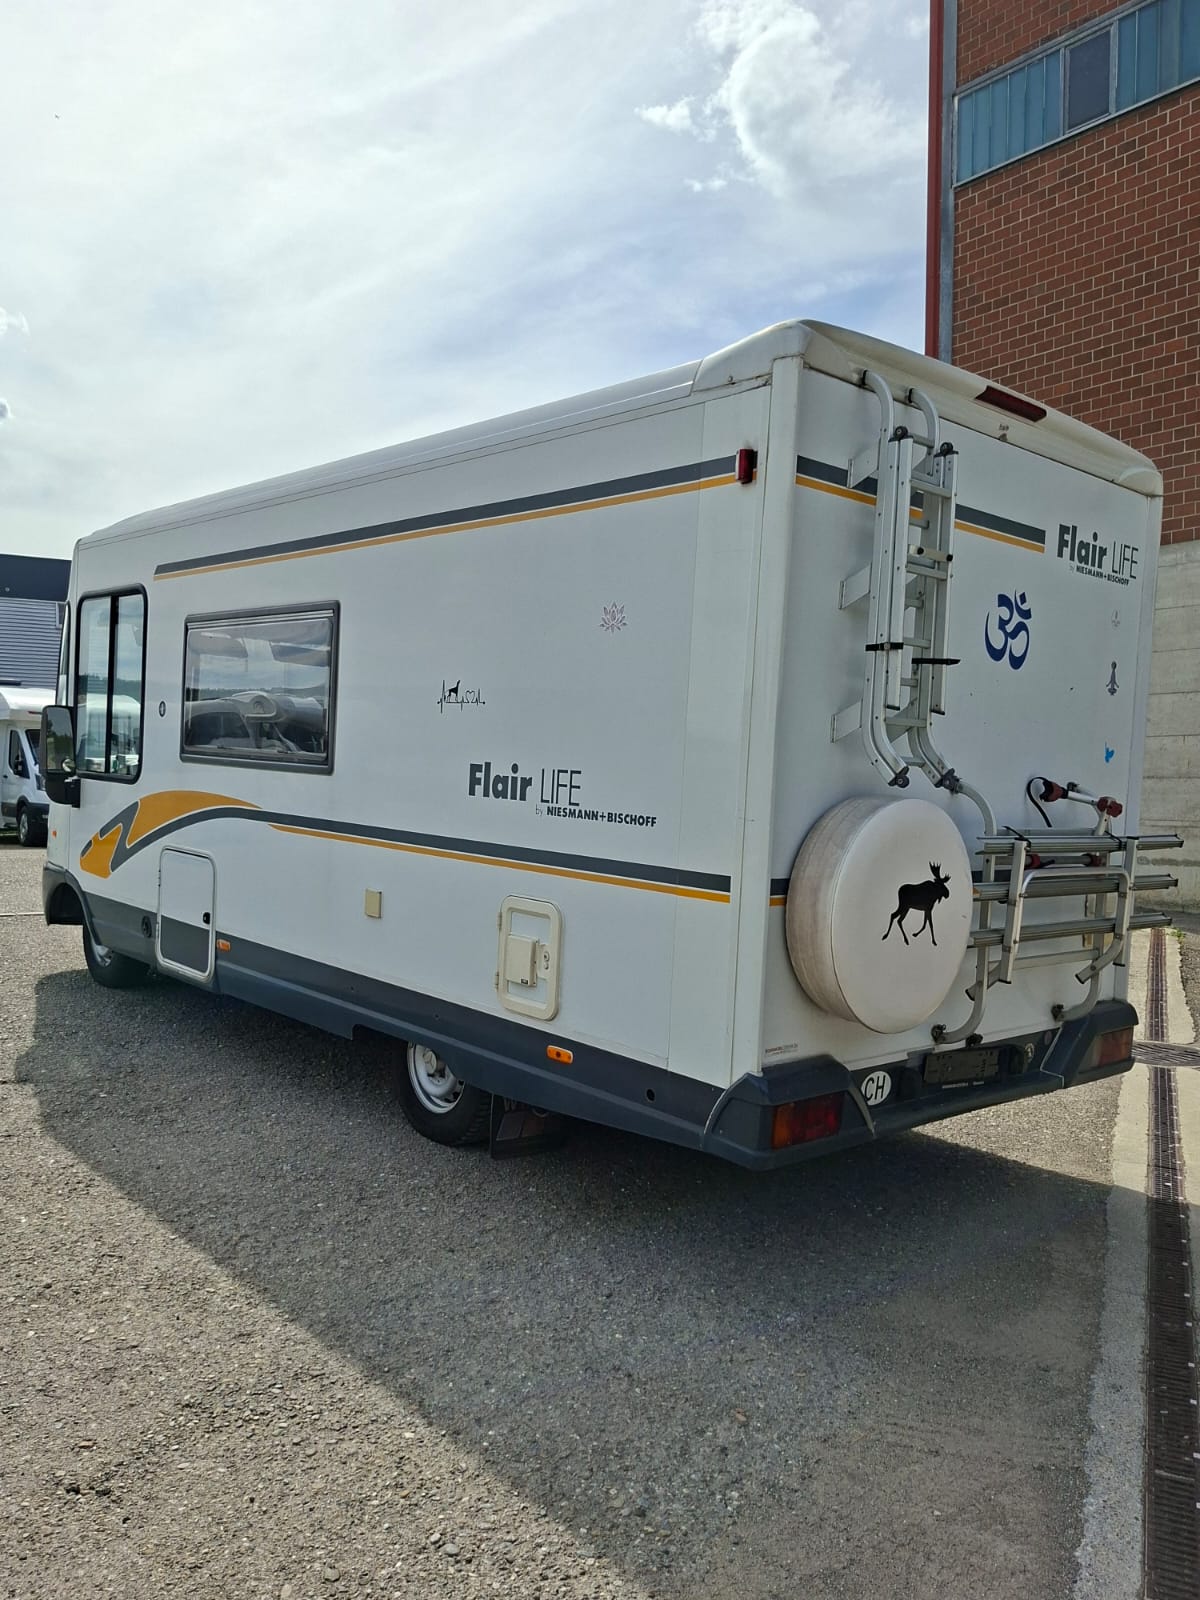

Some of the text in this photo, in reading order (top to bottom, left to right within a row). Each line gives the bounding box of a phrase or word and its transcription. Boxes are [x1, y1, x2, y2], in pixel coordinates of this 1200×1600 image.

[1057, 523, 1139, 580] Flair LIFE
[468, 761, 582, 807] Flair LIFE
[546, 806, 657, 828] NIESMANN+BISCHOFF
[865, 1075, 886, 1101] CH
